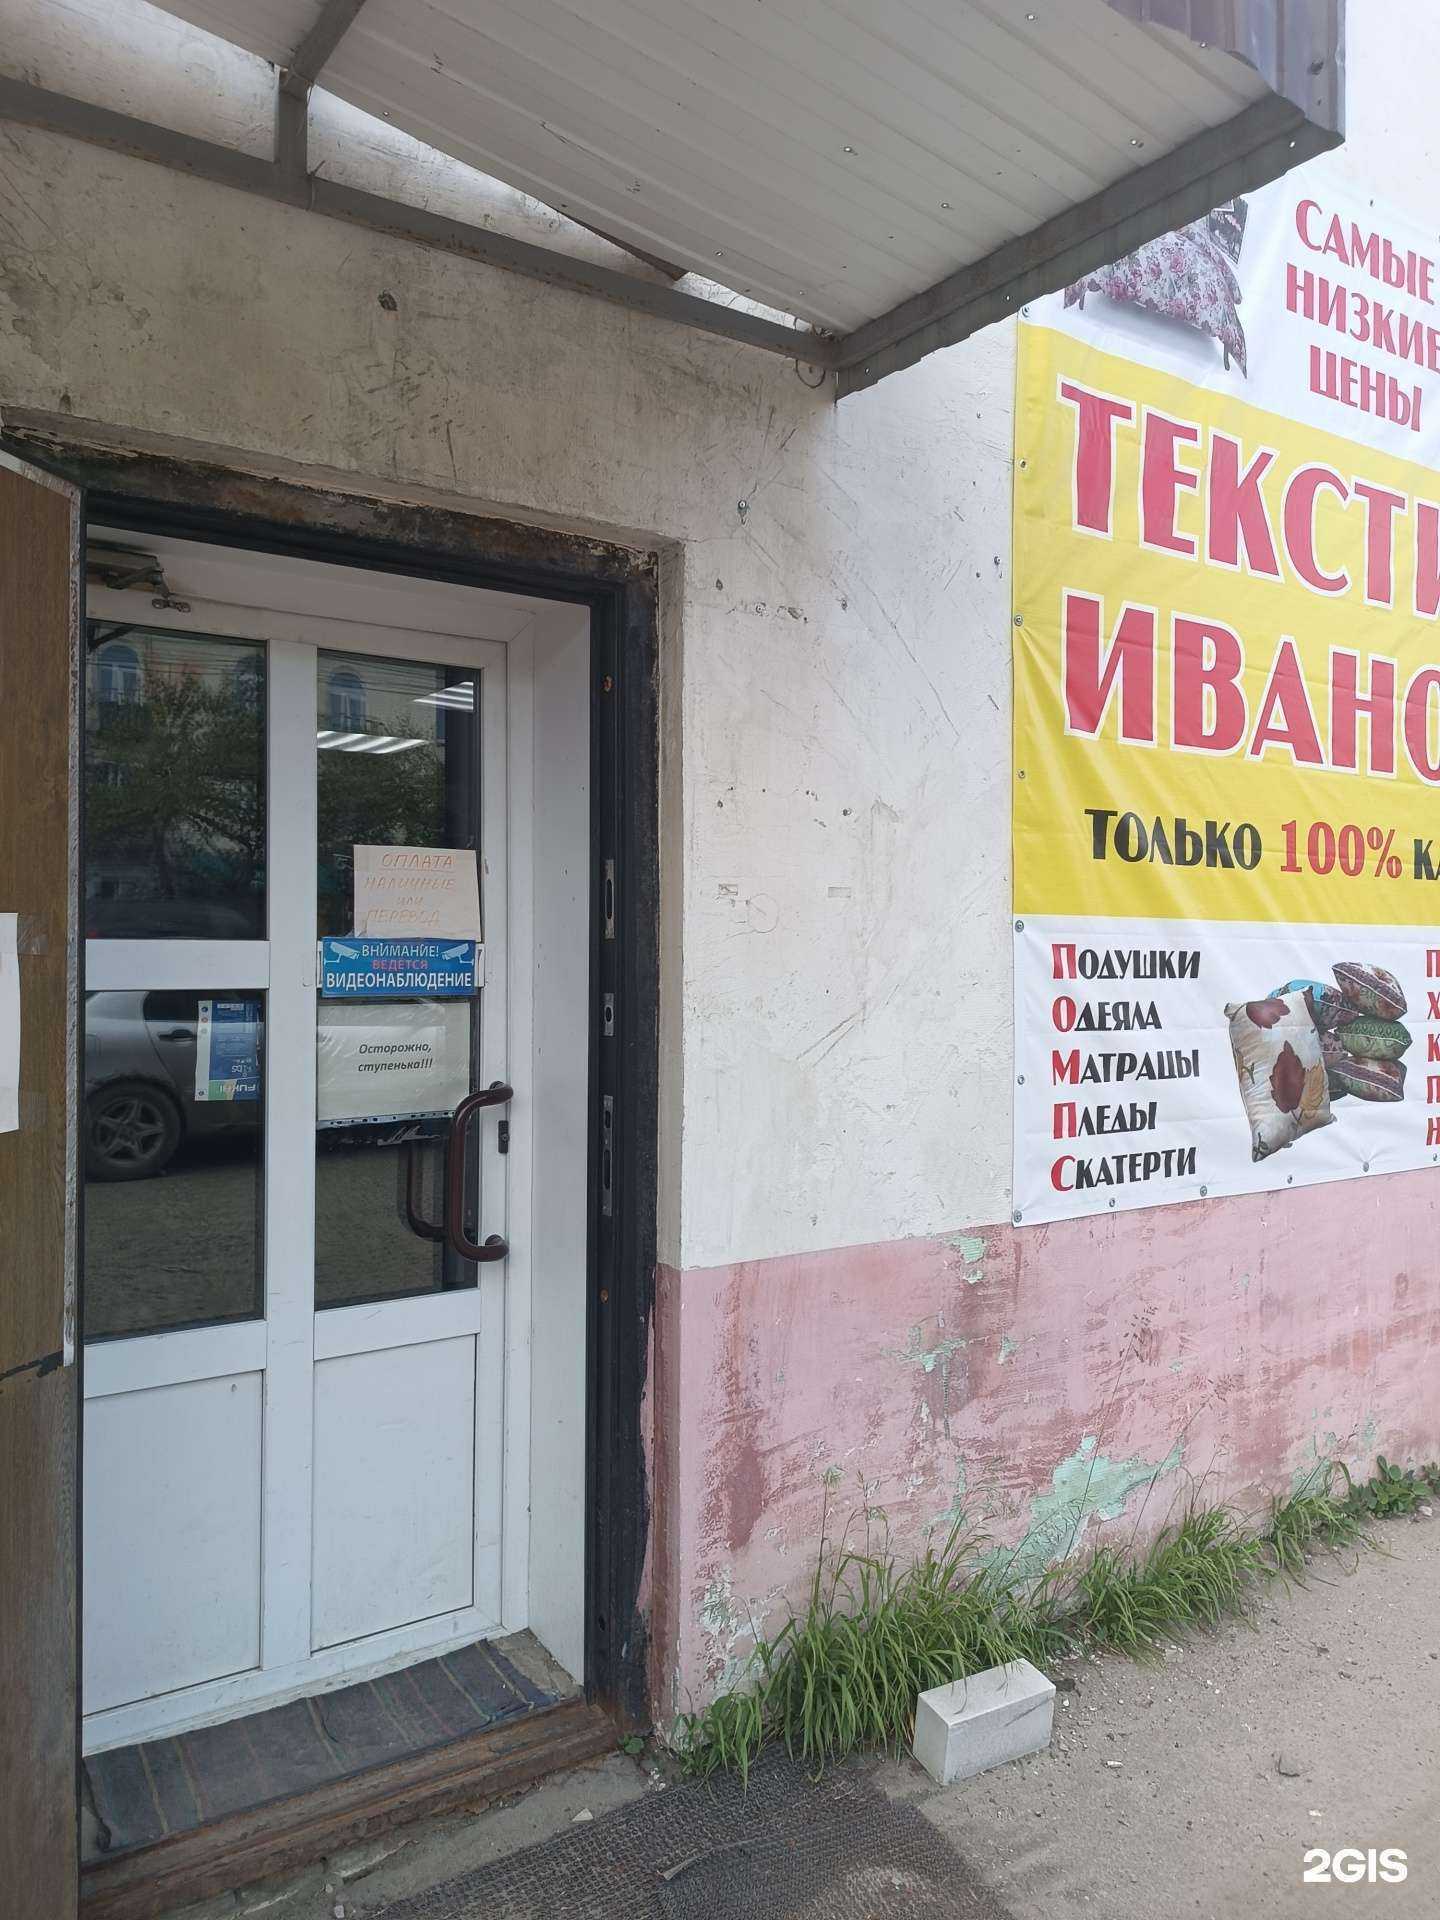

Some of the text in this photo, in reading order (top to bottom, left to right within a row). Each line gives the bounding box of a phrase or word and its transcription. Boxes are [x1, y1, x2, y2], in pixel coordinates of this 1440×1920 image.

[1295, 199, 1434, 306] САМЫЕ
[1286, 262, 1440, 374] НИЗКИЕ
[1310, 344, 1423, 432] ЦЕНЫ
[1084, 808, 1440, 881] ТОЛЬКО 100% К
[382, 853, 456, 868] ОПЛАТА
[362, 943, 440, 958] ВНИМАНИЕ!
[326, 972, 472, 991] ВИДЕОНАБЛЮДЕНИЕ
[358, 1043, 432, 1055] Осторожно,
[358, 1058, 433, 1073] ступенька!!!
